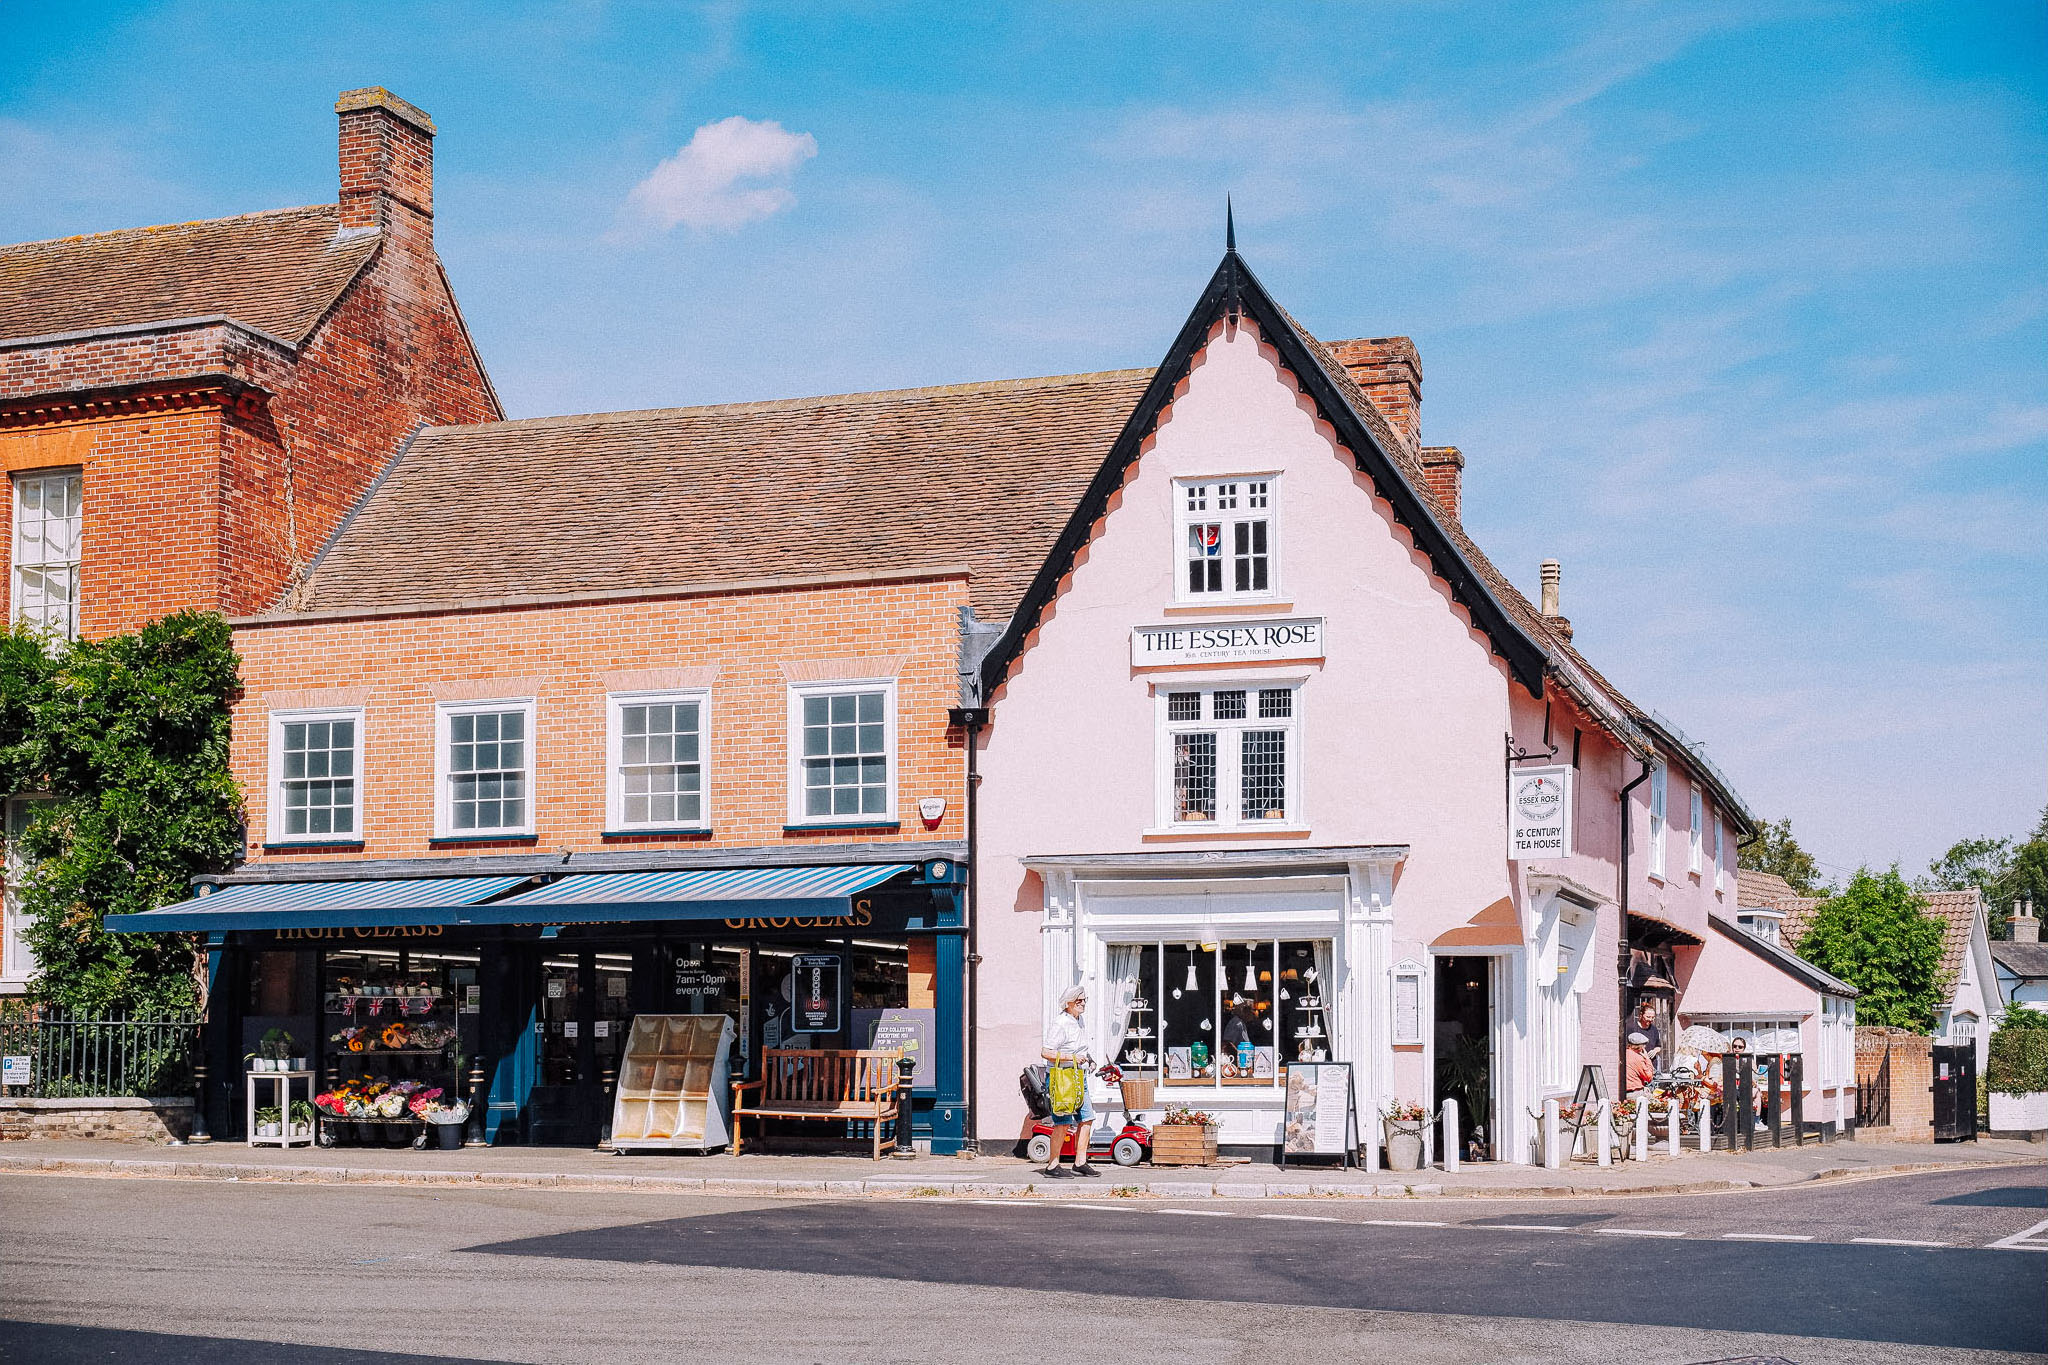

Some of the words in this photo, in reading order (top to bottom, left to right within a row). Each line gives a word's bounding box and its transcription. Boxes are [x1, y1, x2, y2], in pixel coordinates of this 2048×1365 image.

[1142, 632, 1183, 651] THE
[1189, 628, 1259, 649] ESSEX
[1264, 625, 1316, 647] ROSE
[1200, 650, 1230, 658] CENTURY
[1519, 796, 1539, 805] ESSEX
[1540, 794, 1560, 803] ROSE
[1516, 828, 1524, 838] 16
[1526, 827, 1561, 838] CENTURY
[1516, 840, 1532, 850] TEA
[1533, 839, 1561, 849] HOUSE
[676, 957, 701, 969] Open
[675, 987, 701, 997] every
[703, 985, 720, 996] day
